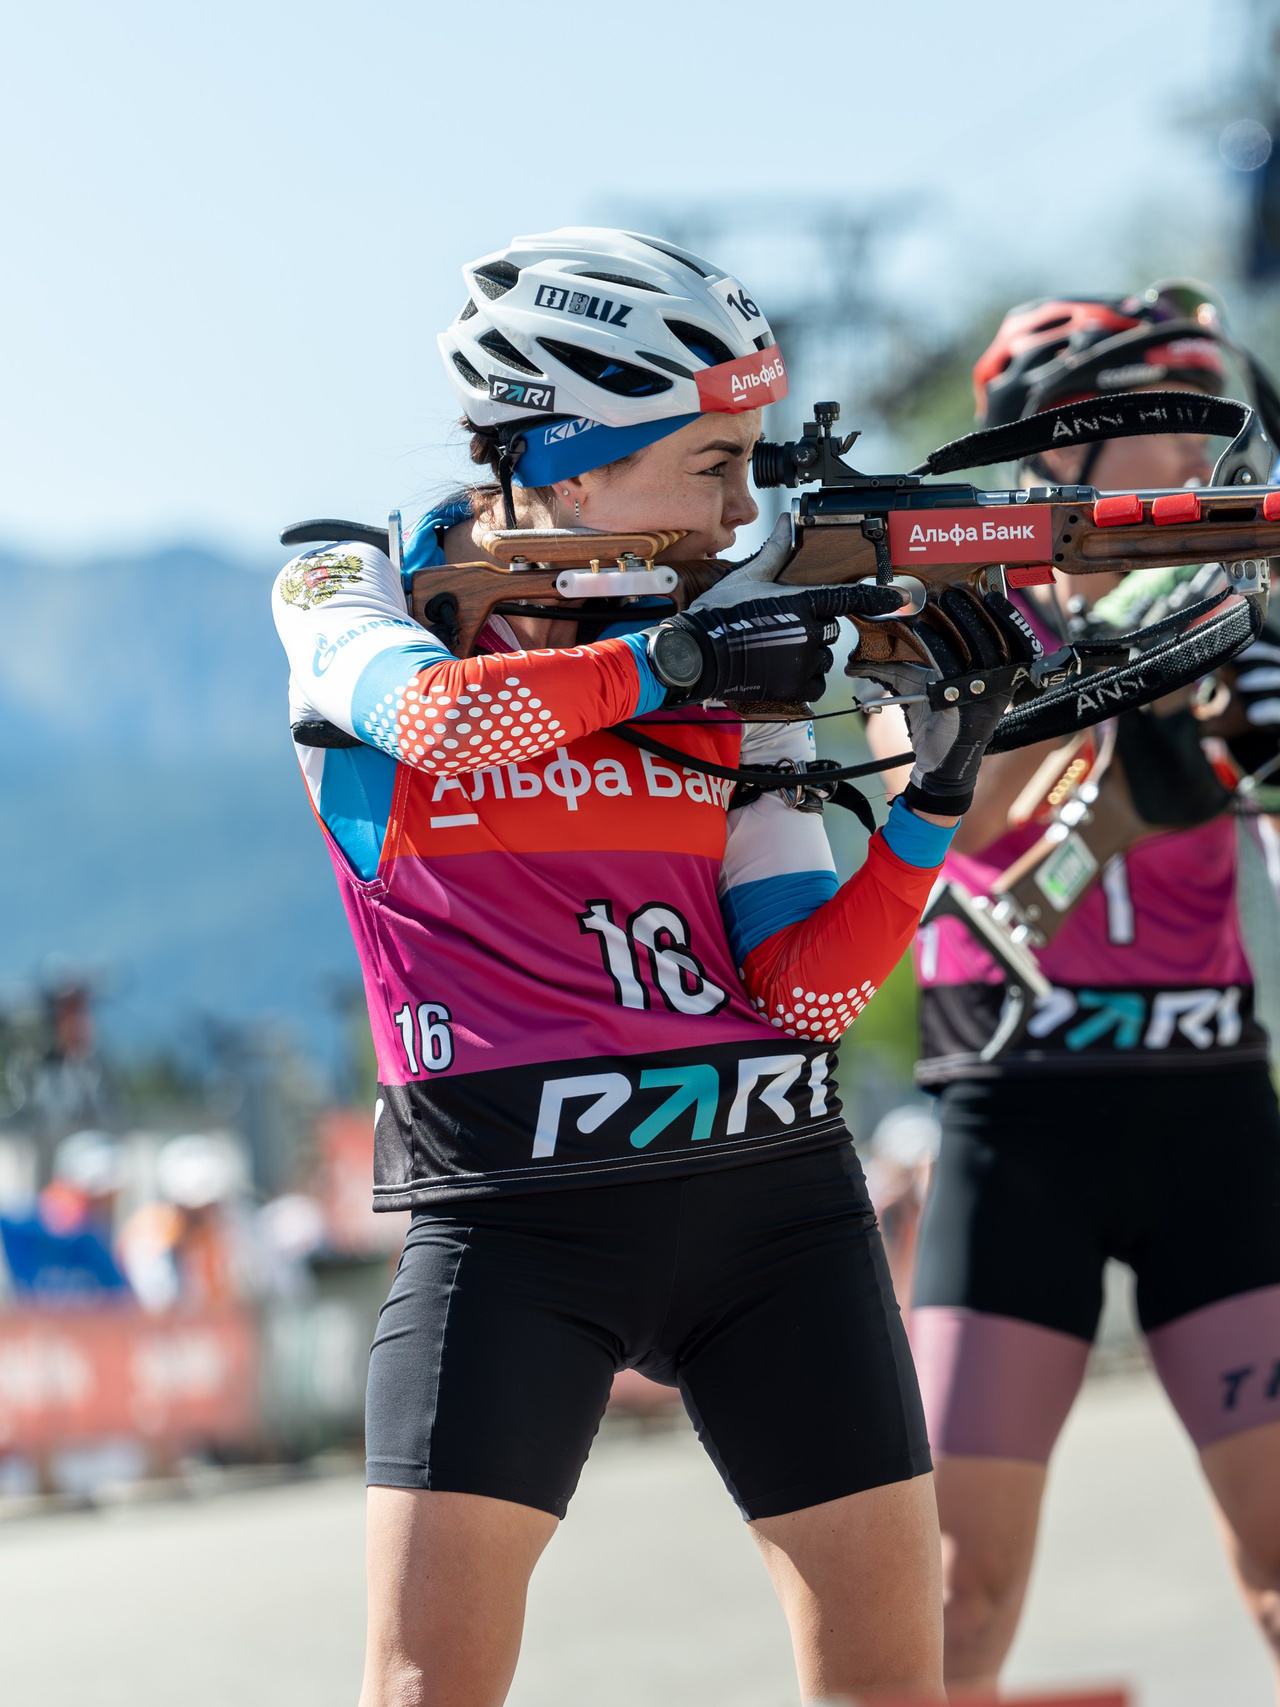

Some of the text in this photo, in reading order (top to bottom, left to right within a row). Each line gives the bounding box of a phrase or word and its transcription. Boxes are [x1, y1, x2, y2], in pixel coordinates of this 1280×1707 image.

[568, 290, 634, 329] BLIZ
[727, 289, 761, 322] 16
[731, 358, 786, 394] Альфа Б
[491, 382, 551, 408] PARI
[545, 420, 600, 445] KV
[909, 521, 1036, 548] Альфа Банк
[576, 899, 731, 1017] 16
[394, 1001, 454, 1076] 16
[531, 1052, 829, 1159] PARI
